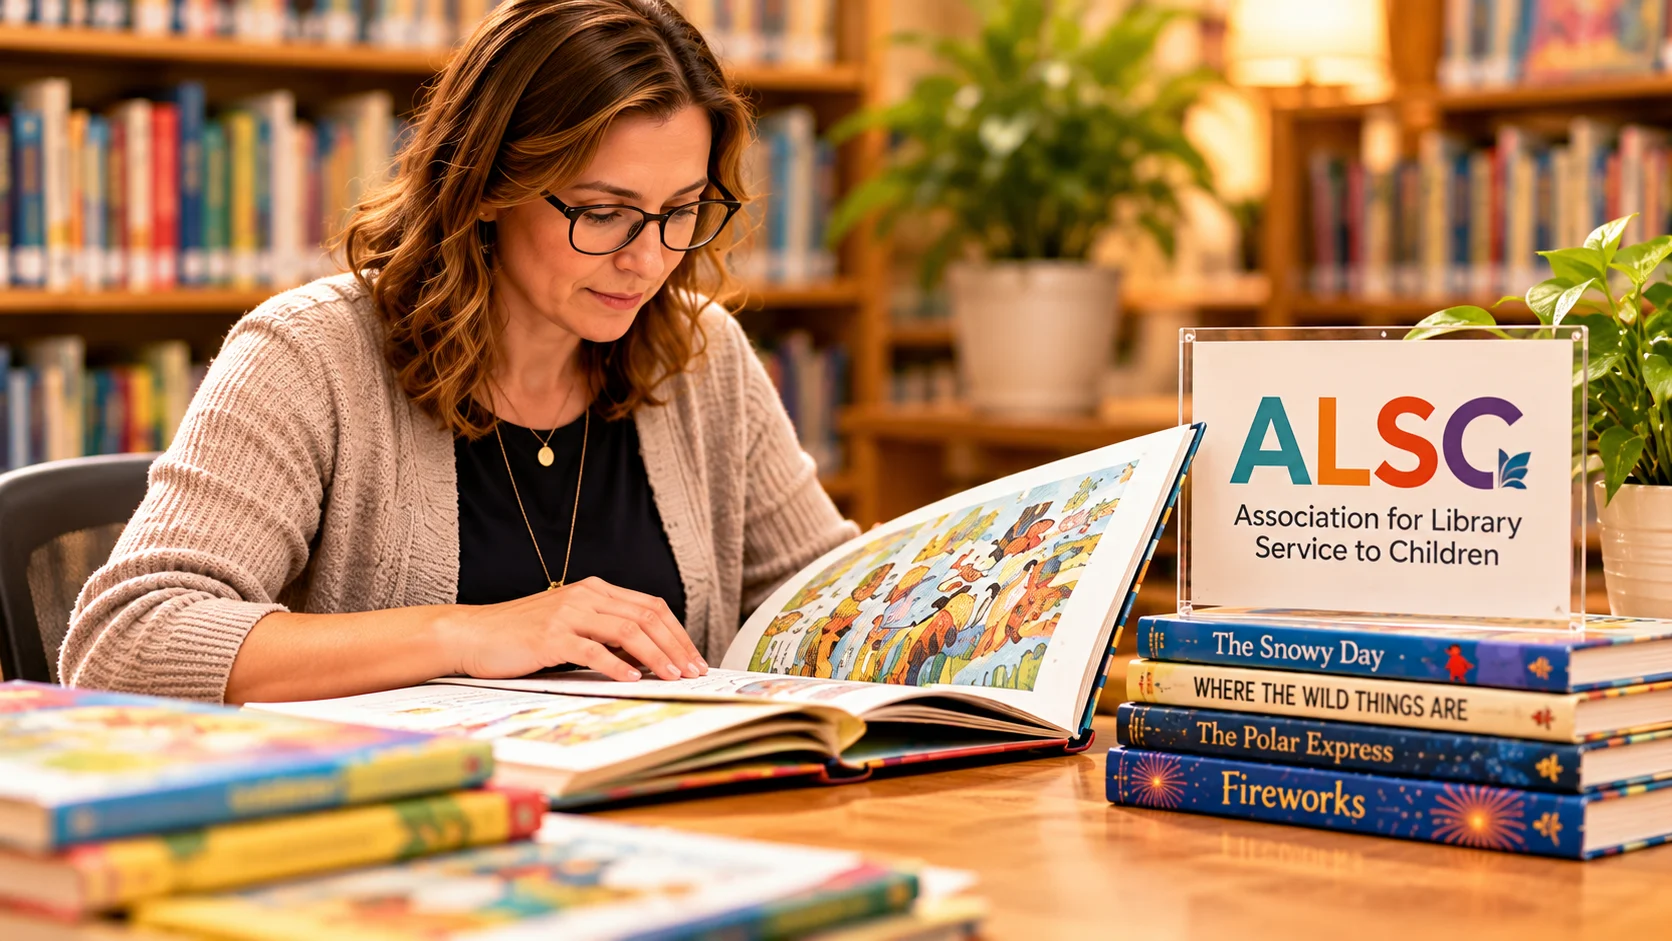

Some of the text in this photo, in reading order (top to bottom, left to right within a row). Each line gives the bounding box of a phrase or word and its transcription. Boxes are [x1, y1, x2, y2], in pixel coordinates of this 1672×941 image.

[1230, 396, 1523, 490] ALSC
[1233, 503, 1522, 539] Association for Library
[1255, 535, 1499, 566] Service to Children
[1212, 631, 1385, 672] The Snowy Day
[1194, 676, 1468, 721] WHERE THE WILD THINGS ARE
[1197, 721, 1394, 765] The Polar Express
[1221, 770, 1366, 819] Fireworks
